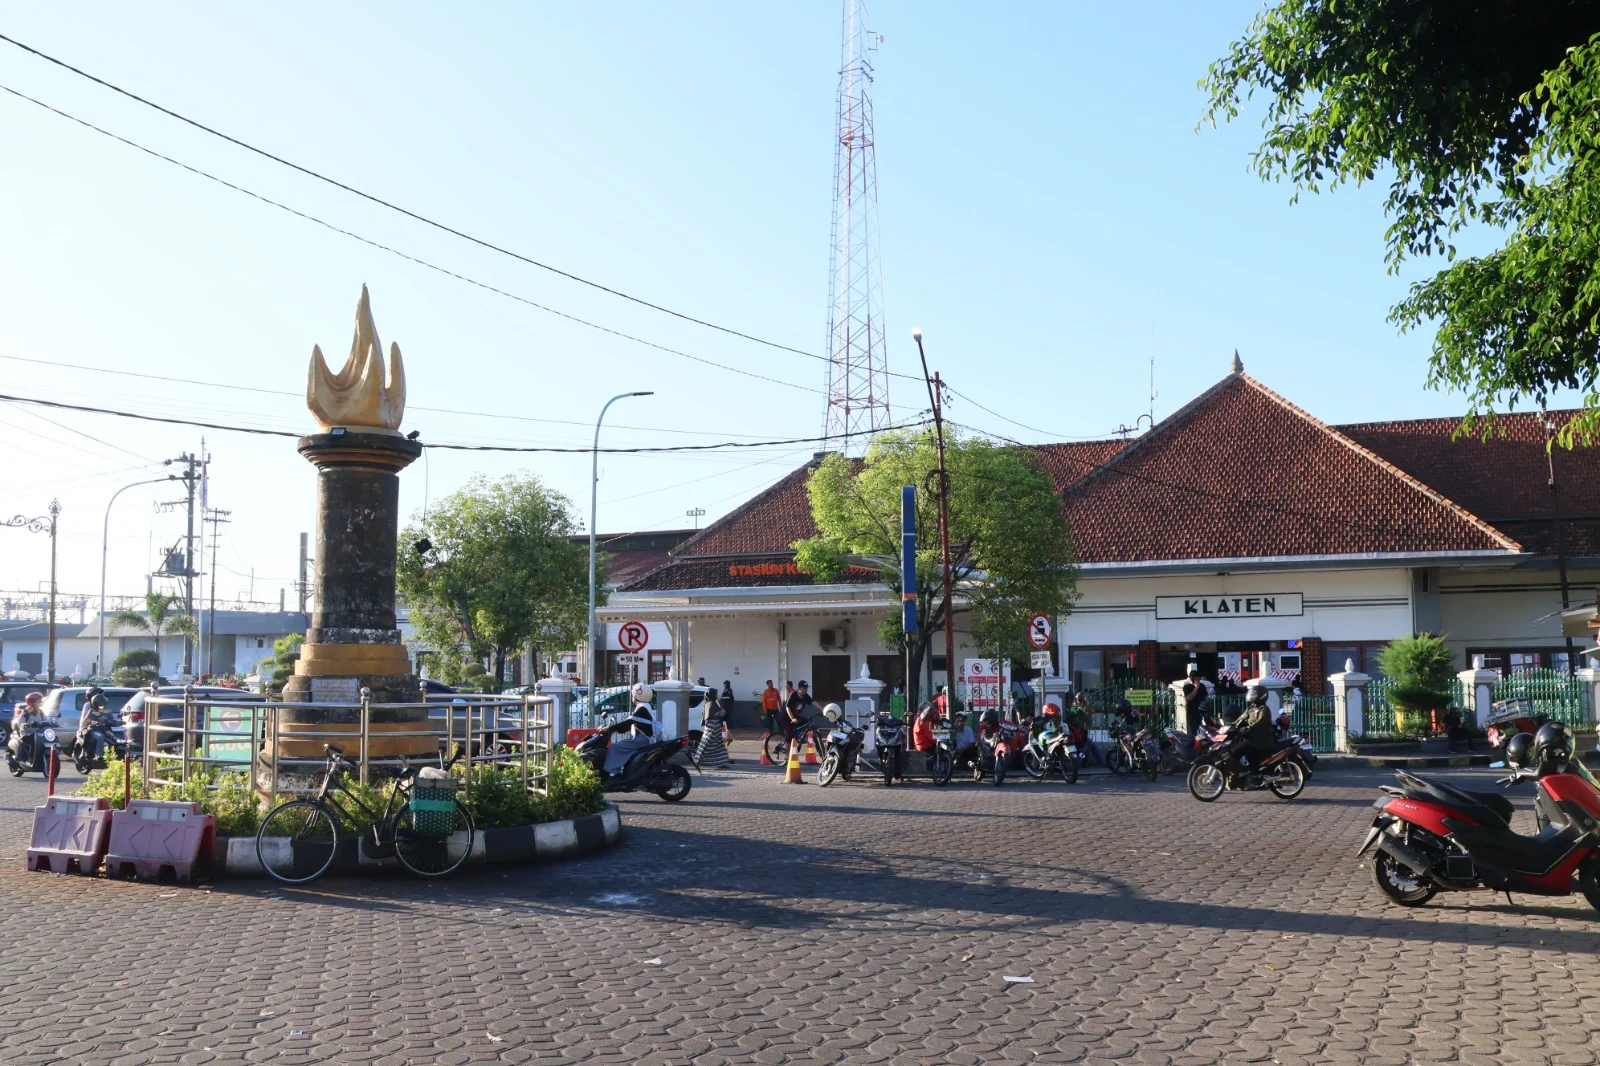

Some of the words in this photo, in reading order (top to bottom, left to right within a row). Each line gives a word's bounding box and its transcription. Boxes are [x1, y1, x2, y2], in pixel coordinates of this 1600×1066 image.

[729, 563, 784, 577] STASIUN
[1184, 597, 1276, 614] KLATEN
[628, 627, 641, 646] P
